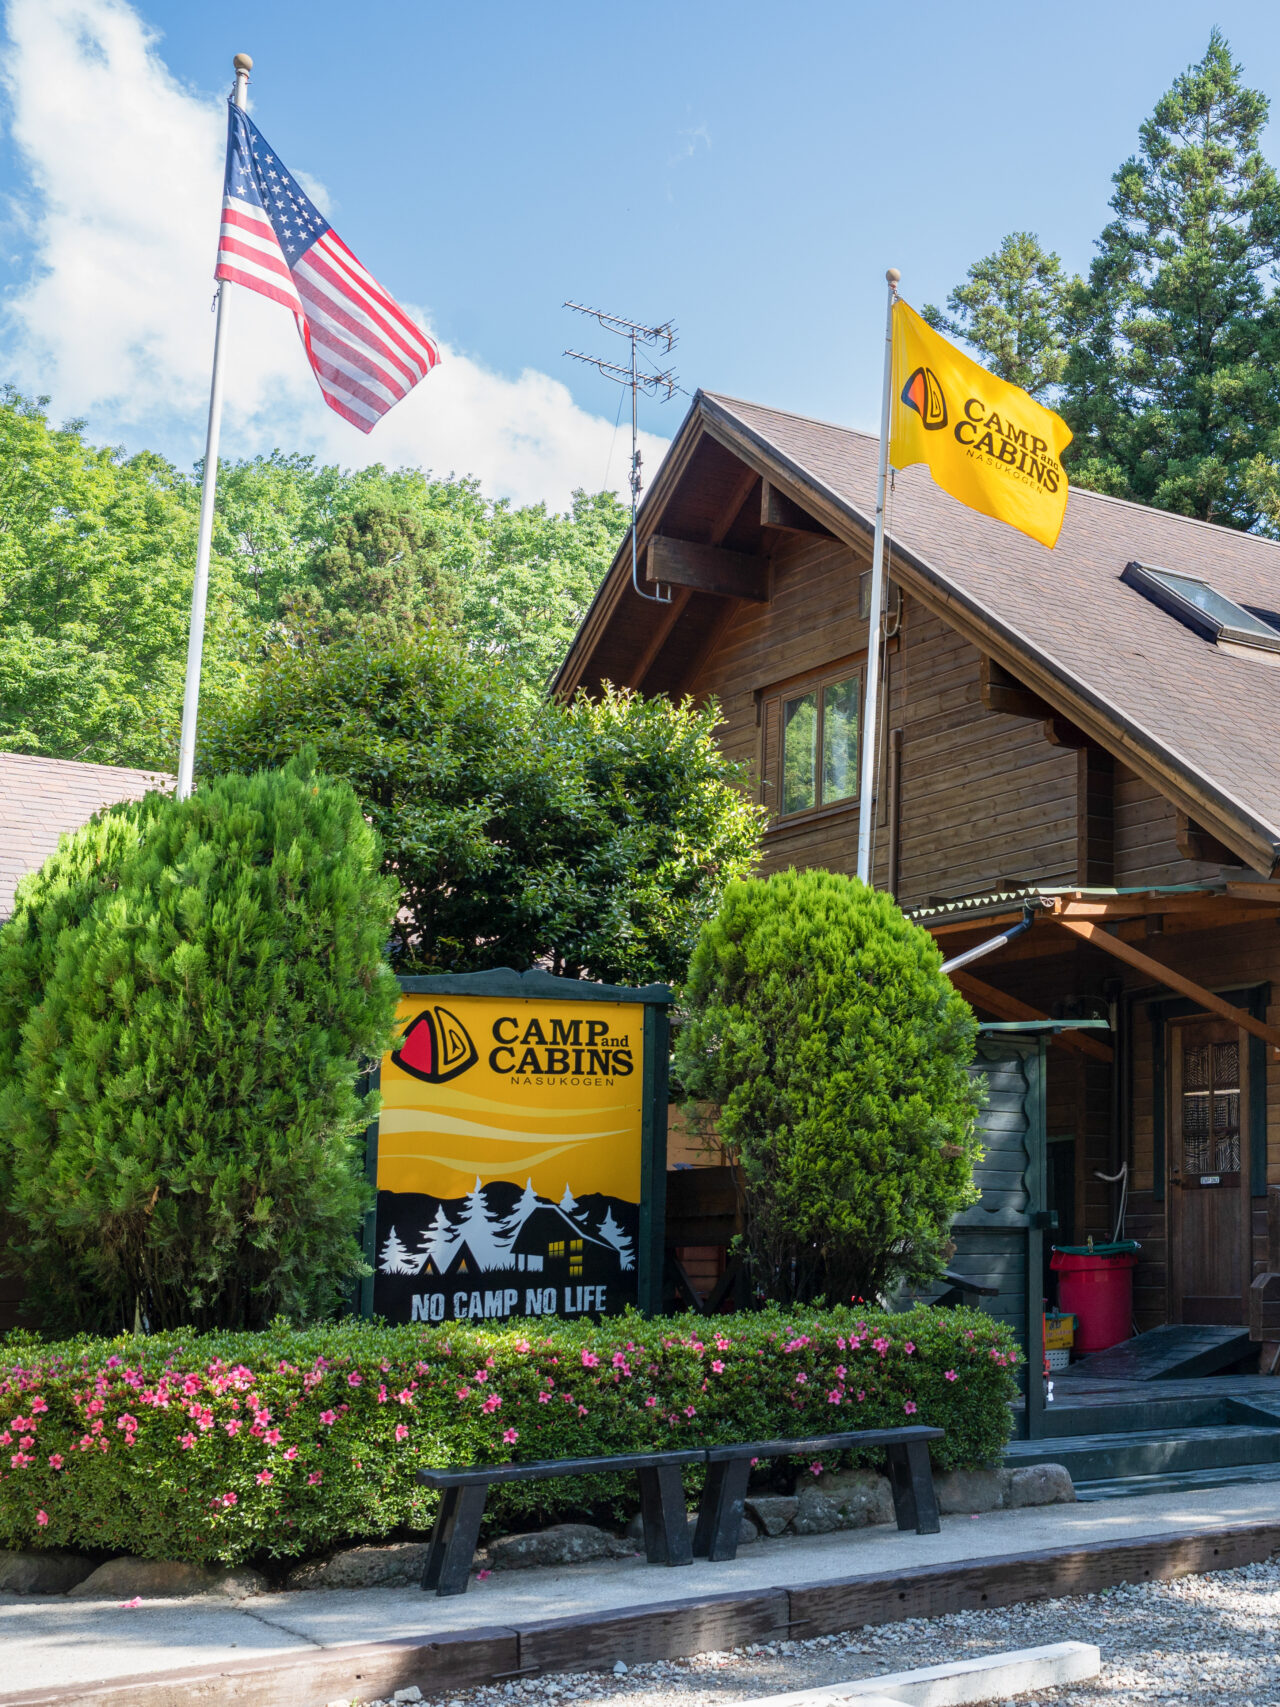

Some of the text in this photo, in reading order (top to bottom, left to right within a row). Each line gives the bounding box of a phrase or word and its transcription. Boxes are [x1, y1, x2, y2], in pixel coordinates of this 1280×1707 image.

[964, 398, 1048, 457] CAMP
[954, 420, 1060, 493] CABINS
[966, 449, 1043, 494] NASUKOGEN
[492, 1017, 629, 1047] CAMP and
[488, 1046, 634, 1077] CABINS
[511, 1076, 614, 1087] NASUKOGEN
[411, 1285, 608, 1321] NO CAMP NO LIFE
